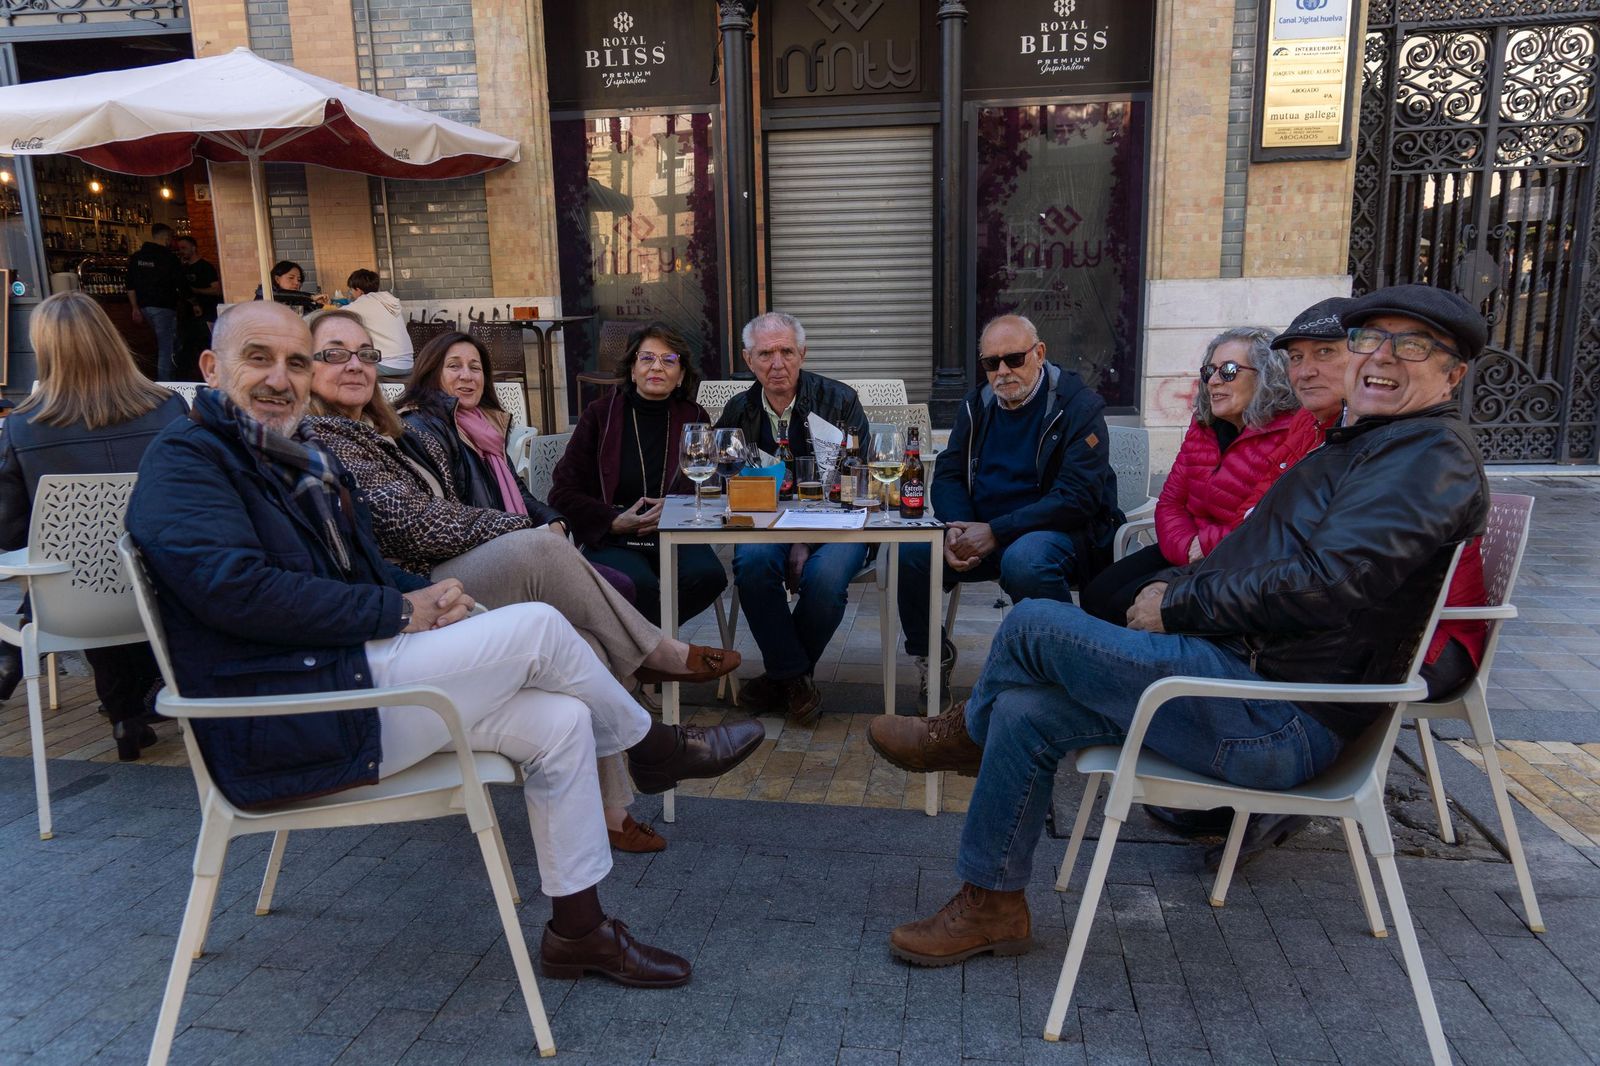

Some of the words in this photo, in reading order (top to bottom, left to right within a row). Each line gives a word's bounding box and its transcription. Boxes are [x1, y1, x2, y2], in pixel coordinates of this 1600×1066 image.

[1278, 16, 1297, 24] Canal
[1320, 14, 1343, 22] huelva
[1040, 20, 1088, 33] ROYAL
[602, 35, 647, 47] ROYAL
[1020, 30, 1107, 55] BLISS
[584, 45, 666, 69] BLISS
[1037, 56, 1091, 65] PREMIUM
[1040, 62, 1085, 75] Inspiration
[602, 70, 652, 79] PREMIUM
[604, 75, 647, 88] Inspiration
[1270, 112, 1300, 121] mutua
[1304, 110, 1337, 121] gallega
[1279, 133, 1319, 141] ABOGADOS
[904, 484, 924, 493] Estrella
[904, 490, 924, 498] Galicia
